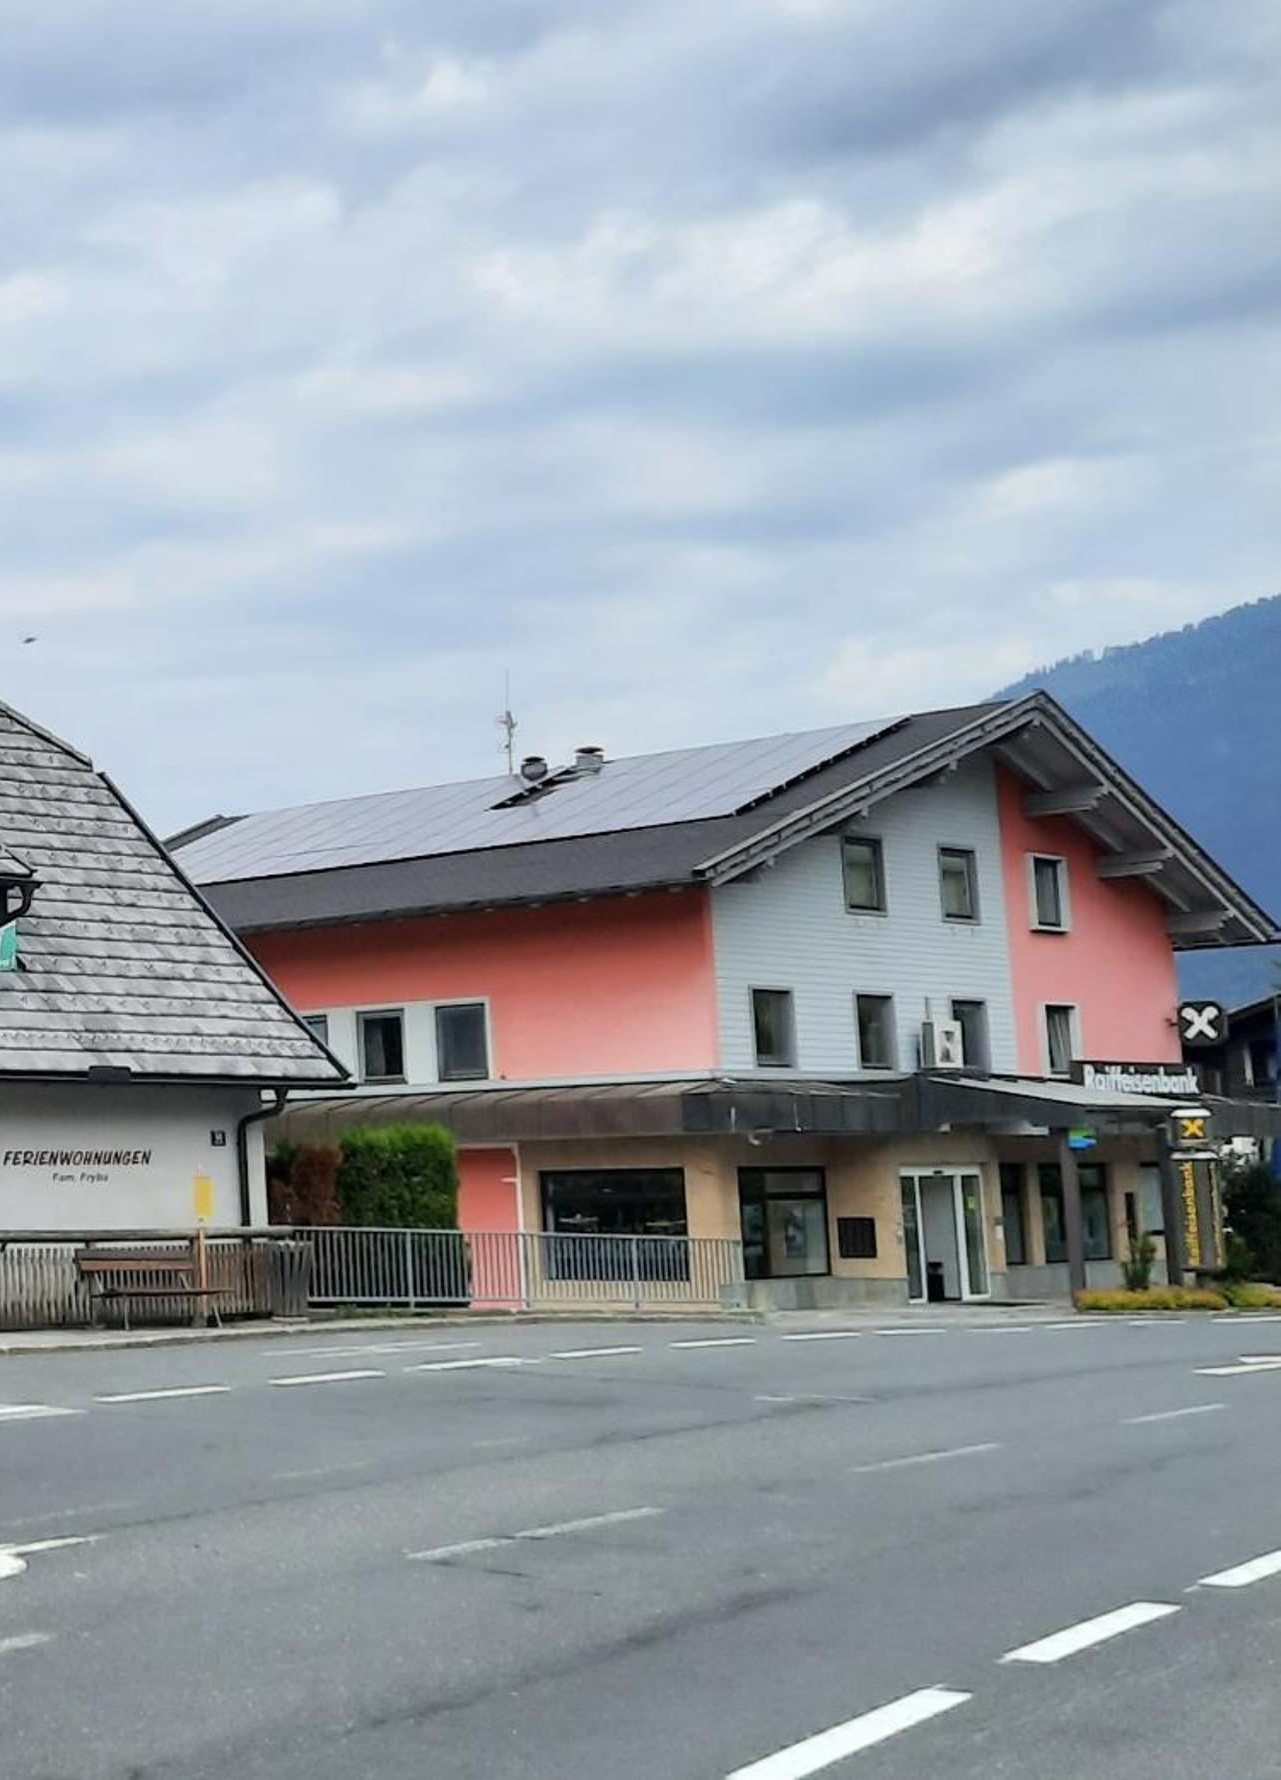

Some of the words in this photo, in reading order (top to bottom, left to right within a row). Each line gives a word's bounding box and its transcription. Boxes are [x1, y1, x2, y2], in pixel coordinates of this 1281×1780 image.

[1083, 1064, 1199, 1094] Raiffeisenbank
[3, 1150, 151, 1166] FERIENWOHNUNGEN
[1179, 1161, 1200, 1267] Raiffeisenbank
